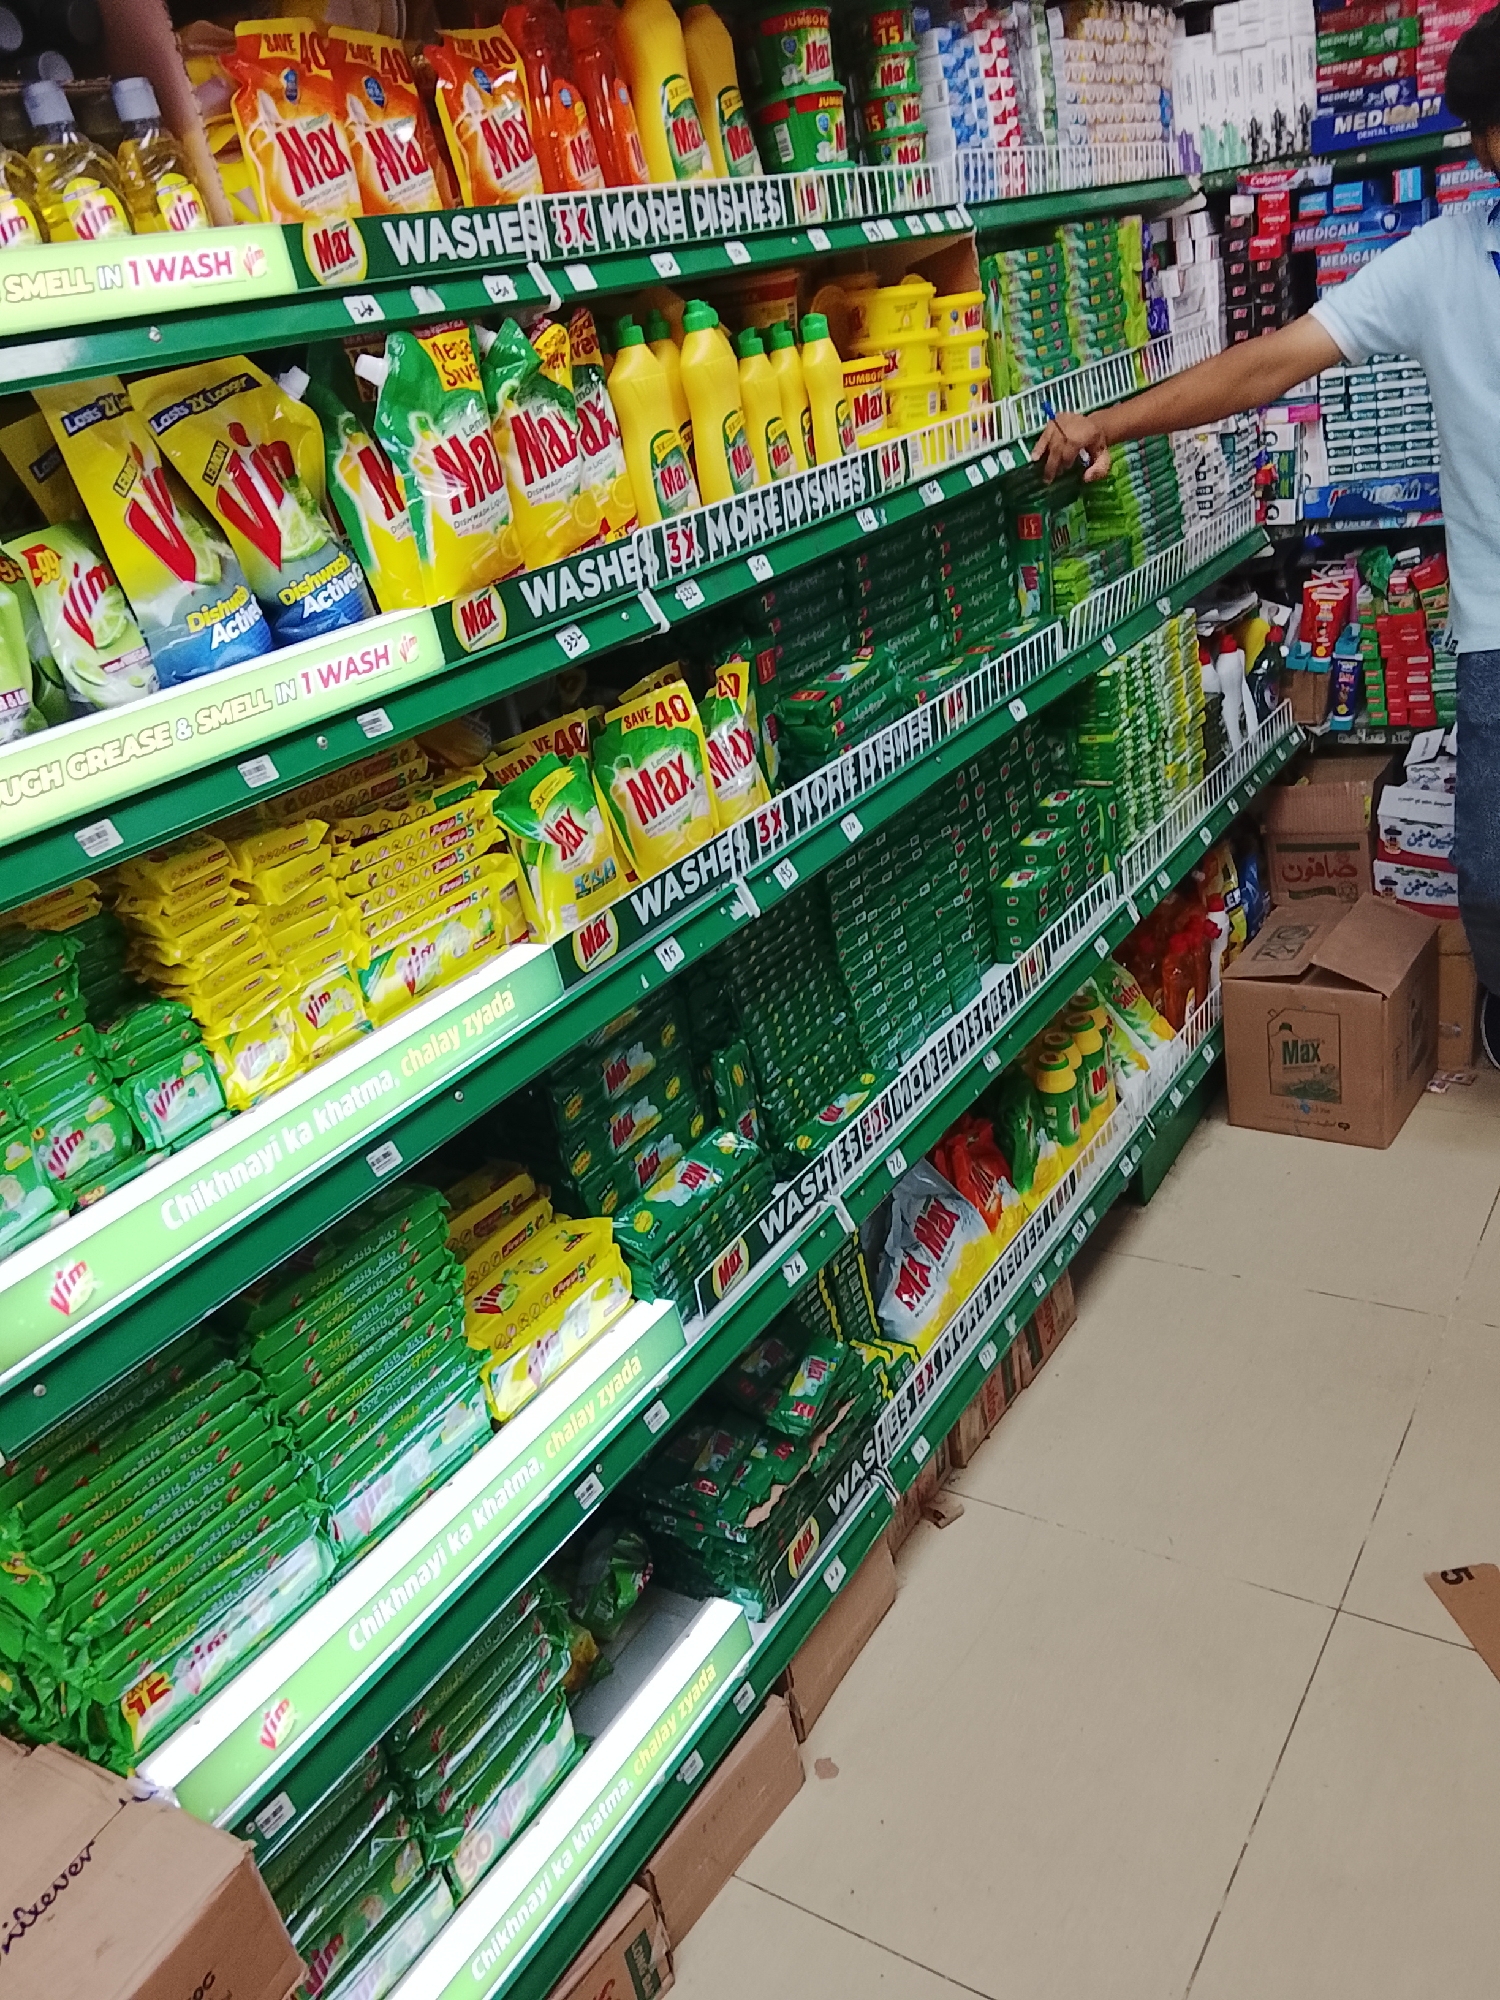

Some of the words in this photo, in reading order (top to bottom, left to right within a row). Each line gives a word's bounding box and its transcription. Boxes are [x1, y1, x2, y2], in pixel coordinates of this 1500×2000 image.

[264, 32, 296, 53] SAVE
[300, 32, 332, 72] 40
[479, 36, 517, 69] 40
[876, 26, 902, 46] 15
[379, 46, 413, 85] 40
[880, 63, 906, 89] Max
[1357, 127, 1388, 140] DENTAL
[1389, 121, 1419, 134] CREAM
[274, 122, 353, 198] Max
[897, 147, 921, 165] Max
[1250, 174, 1288, 186] Colgate
[382, 207, 541, 266] WASHES
[600, 196, 687, 244] MORE
[690, 185, 785, 234] DISHES
[1294, 221, 1360, 244] MEDICAM
[313, 228, 356, 274] Max
[3, 268, 95, 304] SMELL
[97, 265, 122, 291] IN
[128, 260, 141, 287] 1
[146, 251, 234, 284] WASH
[843, 374, 877, 387] JUMBO
[63, 405, 102, 436] Lasts
[101, 393, 122, 416] 2X
[151, 402, 191, 435] Lasts
[189, 393, 206, 413] 2X
[577, 392, 621, 457] ax
[854, 392, 885, 428] Max
[203, 440, 229, 487] LEMON
[510, 408, 578, 486] Max
[431, 428, 504, 516] Ma
[660, 465, 690, 501] Max
[217, 422, 296, 573] Vim
[519, 538, 660, 619] WASHES
[665, 525, 703, 565] 3X
[706, 490, 784, 555] MORE
[786, 463, 866, 520] DISHES
[279, 552, 351, 606] Dishwash
[679, 586, 697, 602] 332
[63, 561, 114, 650] Vim
[186, 585, 251, 634] Dishwash
[461, 594, 497, 641] Max
[564, 630, 584, 652] 332
[0, 760, 64, 807] UGH
[66, 721, 174, 781] GREASE
[175, 717, 195, 742] &
[197, 689, 273, 736] SMELL
[275, 678, 297, 705] IN
[301, 670, 312, 695] 1
[317, 644, 391, 690] WASH
[622, 708, 652, 731] SAVE
[655, 694, 690, 728] 40
[554, 721, 590, 759] 40
[651, 744, 679, 769] Lemon
[626, 753, 696, 827] Max
[543, 808, 588, 862] Max
[631, 824, 751, 926] WASHES
[757, 803, 784, 845] 3X
[791, 758, 860, 824] MORE
[859, 708, 933, 777] DISHES
[580, 918, 613, 963] Max
[304, 991, 331, 1029] Vim
[1281, 1039, 1321, 1066] Max
[152, 1076, 185, 1121] Vim
[161, 1136, 280, 1232] Chikhnayi
[283, 1112, 314, 1154] ka
[313, 1068, 401, 1135] khatma,
[400, 1023, 462, 1079] chalay
[460, 987, 516, 1039] zyada
[47, 1129, 85, 1181] Vim
[759, 1122, 863, 1245] WASHES
[914, 1198, 961, 1262] Max
[50, 1260, 89, 1316] Vim
[718, 1247, 744, 1298] Max
[347, 1543, 447, 1653] Chikhnayi
[446, 1524, 474, 1559] ka
[472, 1457, 545, 1533] khatma,
[544, 1403, 595, 1461] chalay
[594, 1353, 642, 1415] zyada
[792, 1523, 815, 1567] Max
[260, 1698, 290, 1751] Vim
[470, 1873, 554, 1983] Chikhnayi
[550, 1848, 575, 1882] ka
[632, 1713, 678, 1777] chalay
[676, 1661, 718, 1722] zyada
[305, 1932, 345, 1998] Vim
